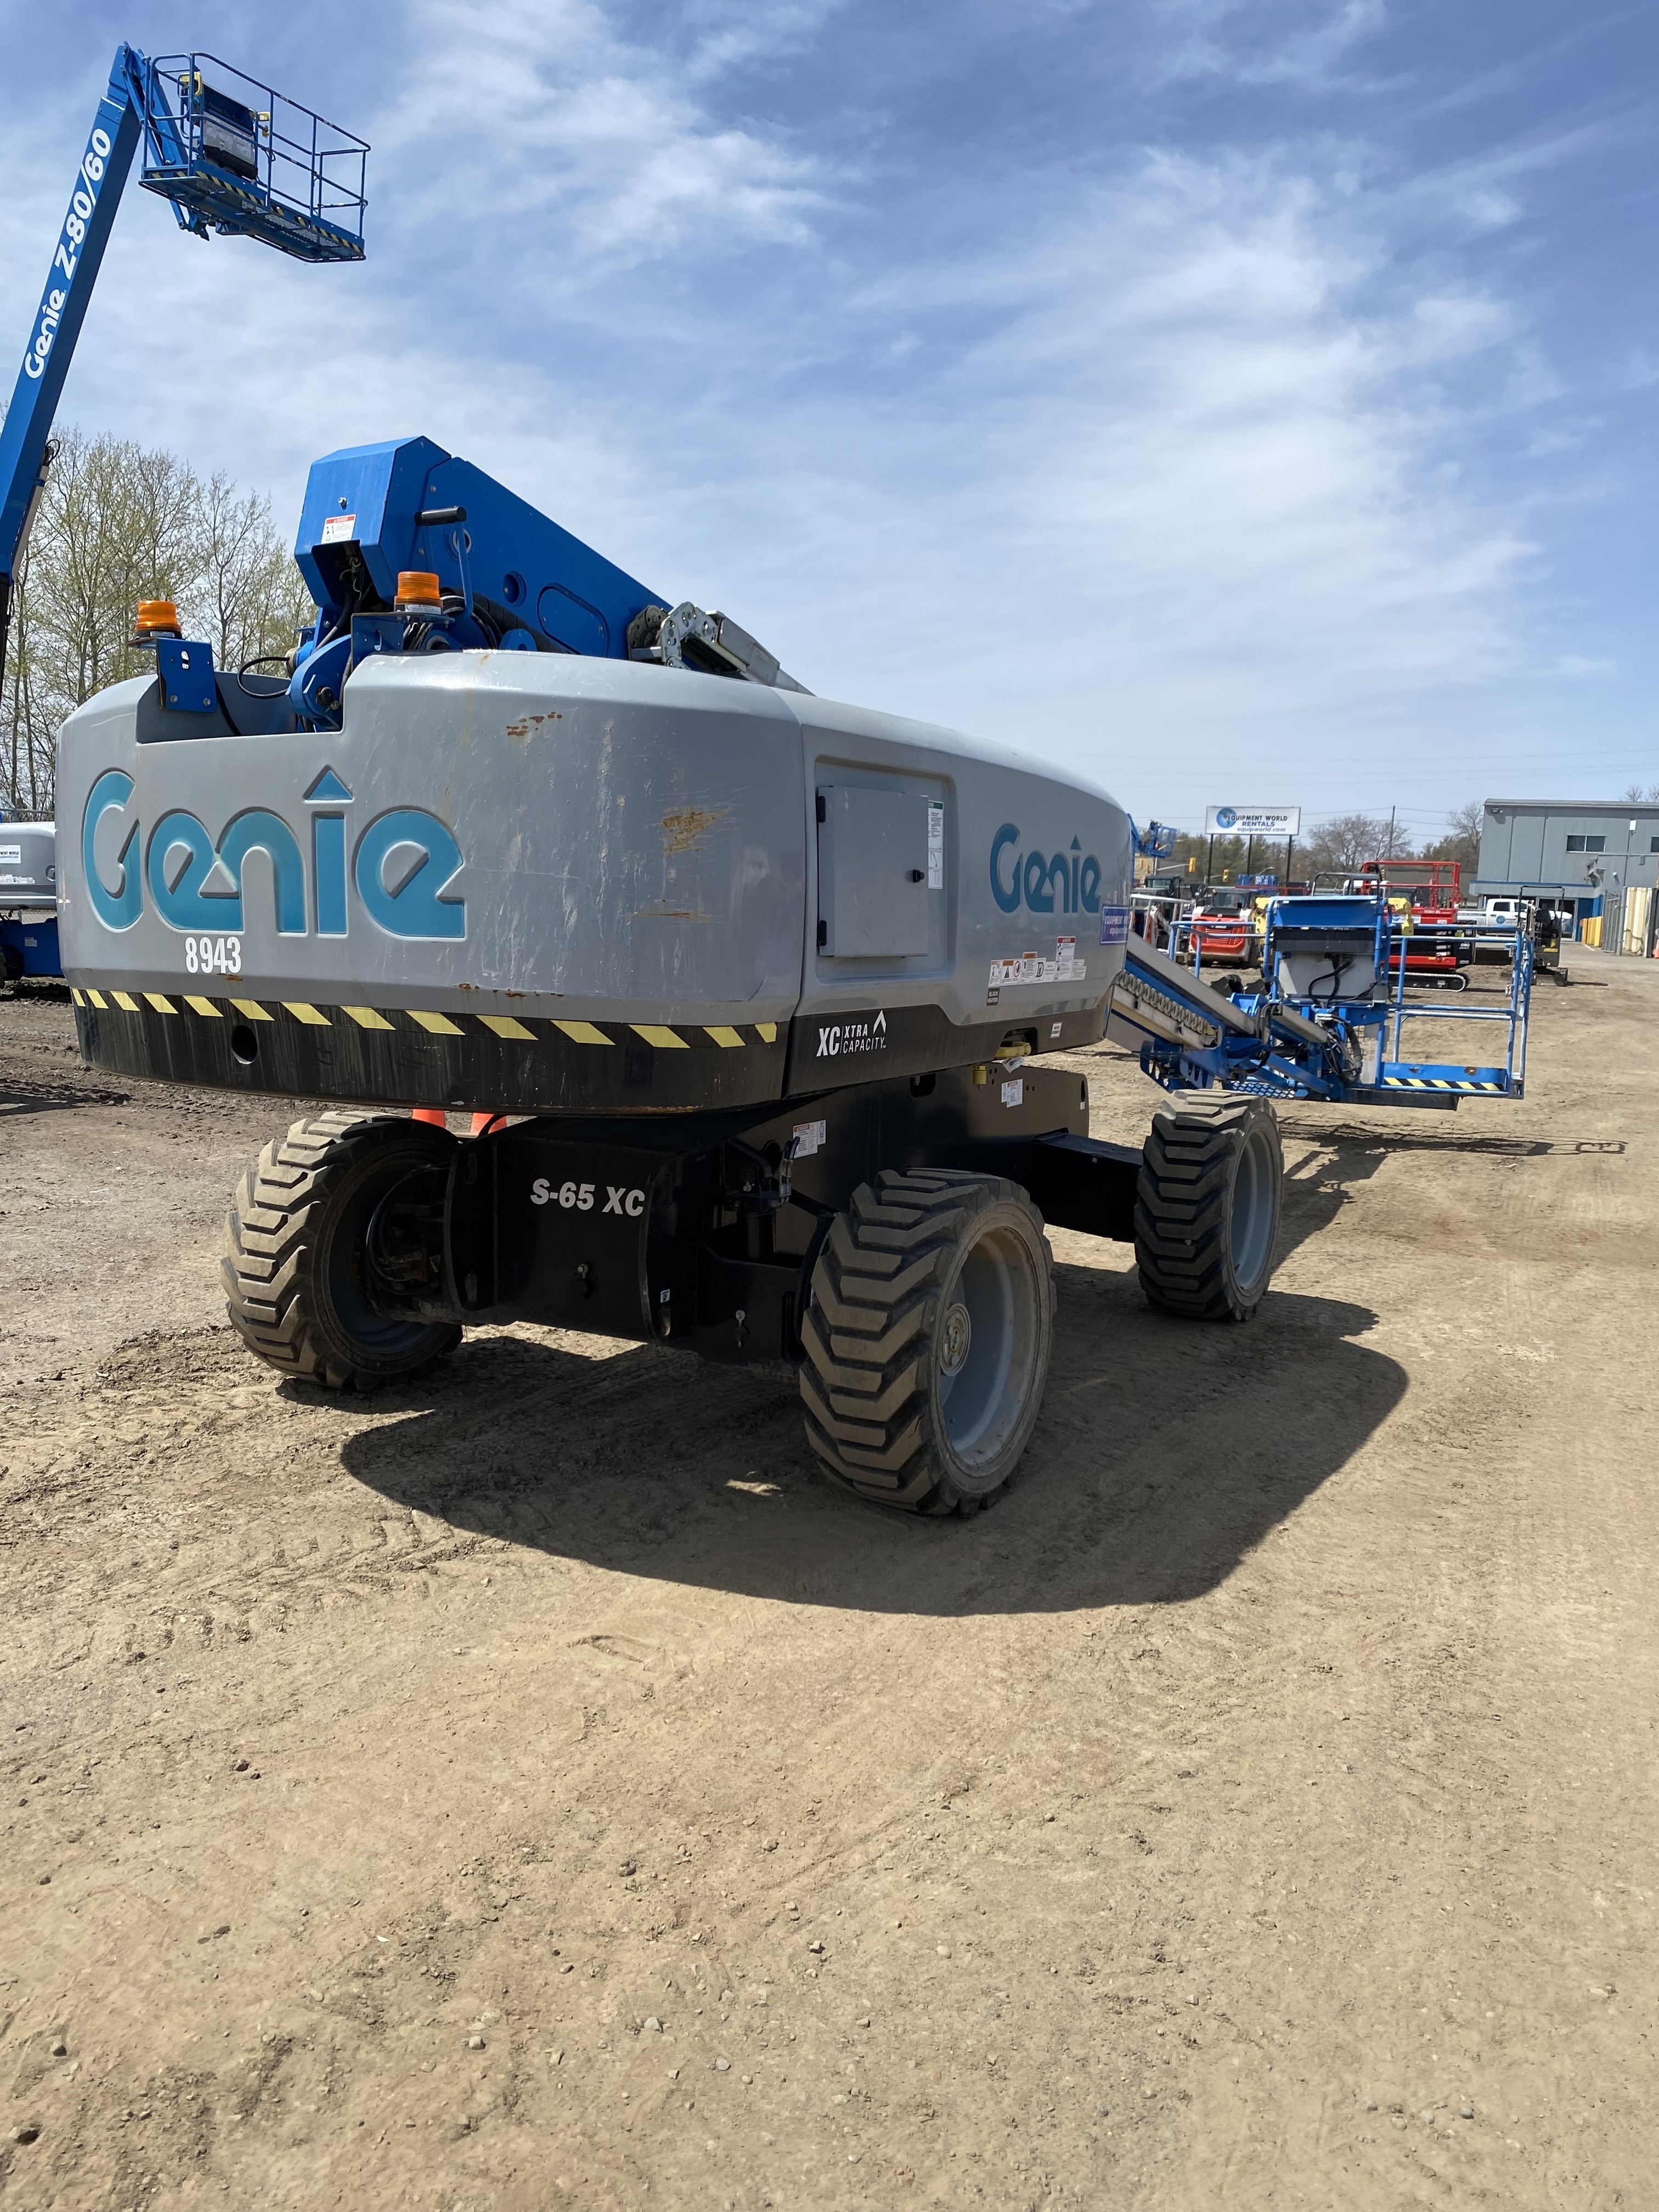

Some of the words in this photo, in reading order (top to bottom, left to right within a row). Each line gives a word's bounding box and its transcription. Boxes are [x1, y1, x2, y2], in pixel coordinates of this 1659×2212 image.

[25, 289, 66, 379] Genie
[55, 128, 110, 279] Z-80/60
[83, 766, 465, 939] Genie
[990, 823, 1101, 913] Genie
[185, 936, 241, 974] 8943
[816, 1026, 840, 1057] XC
[844, 1024, 868, 1039] XTRA
[843, 1036, 885, 1054] CAPACITY
[530, 1178, 595, 1210] S-65
[602, 1186, 645, 1216] XC
